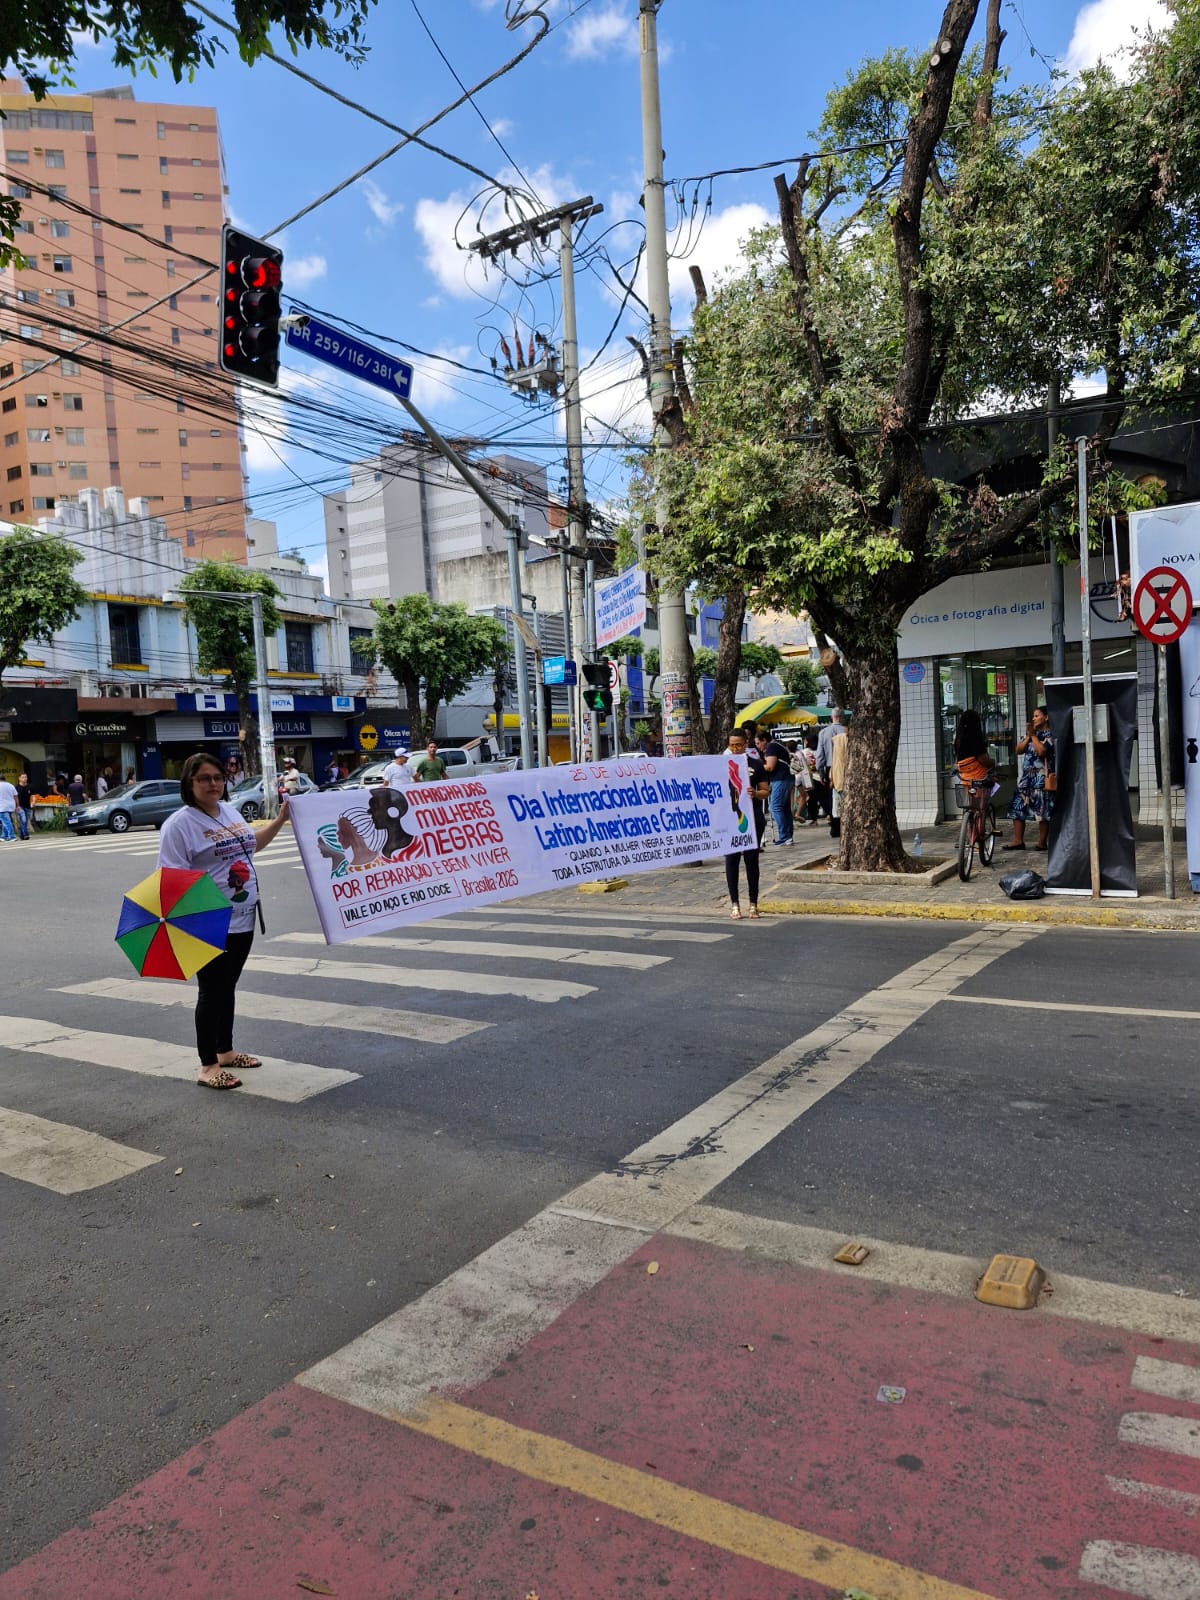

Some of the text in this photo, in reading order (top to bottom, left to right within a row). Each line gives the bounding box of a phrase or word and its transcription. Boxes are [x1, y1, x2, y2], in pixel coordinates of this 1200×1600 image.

[293, 326, 310, 342] BR
[1162, 553, 1195, 565] NOVA
[910, 601, 1045, 625] Ótica e fotografia digital
[569, 763, 657, 781] 25 DE JULHO
[406, 782, 487, 806] MARCHA DAS
[507, 777, 723, 822] Dia Internacional da Mulher Negra
[415, 799, 495, 829] MULHERES
[650, 814, 661, 833] e
[659, 803, 710, 832] Caribenha
[422, 820, 504, 858] NEGRAS
[604, 845, 610, 855] A
[611, 839, 640, 853] MULHER
[641, 837, 665, 849] NEGRA
[665, 835, 674, 846] SE
[332, 847, 512, 902] POR REPARAÇÃO E BEM VIVER
[552, 866, 574, 881] TODA
[574, 864, 581, 876] A
[582, 857, 621, 875] ESTRUTURA
[621, 854, 631, 865] DA
[631, 849, 663, 863] SOCIEDADE
[663, 847, 671, 858] SE
[344, 883, 452, 922] VALE DO AÇO E RIO DOCE
